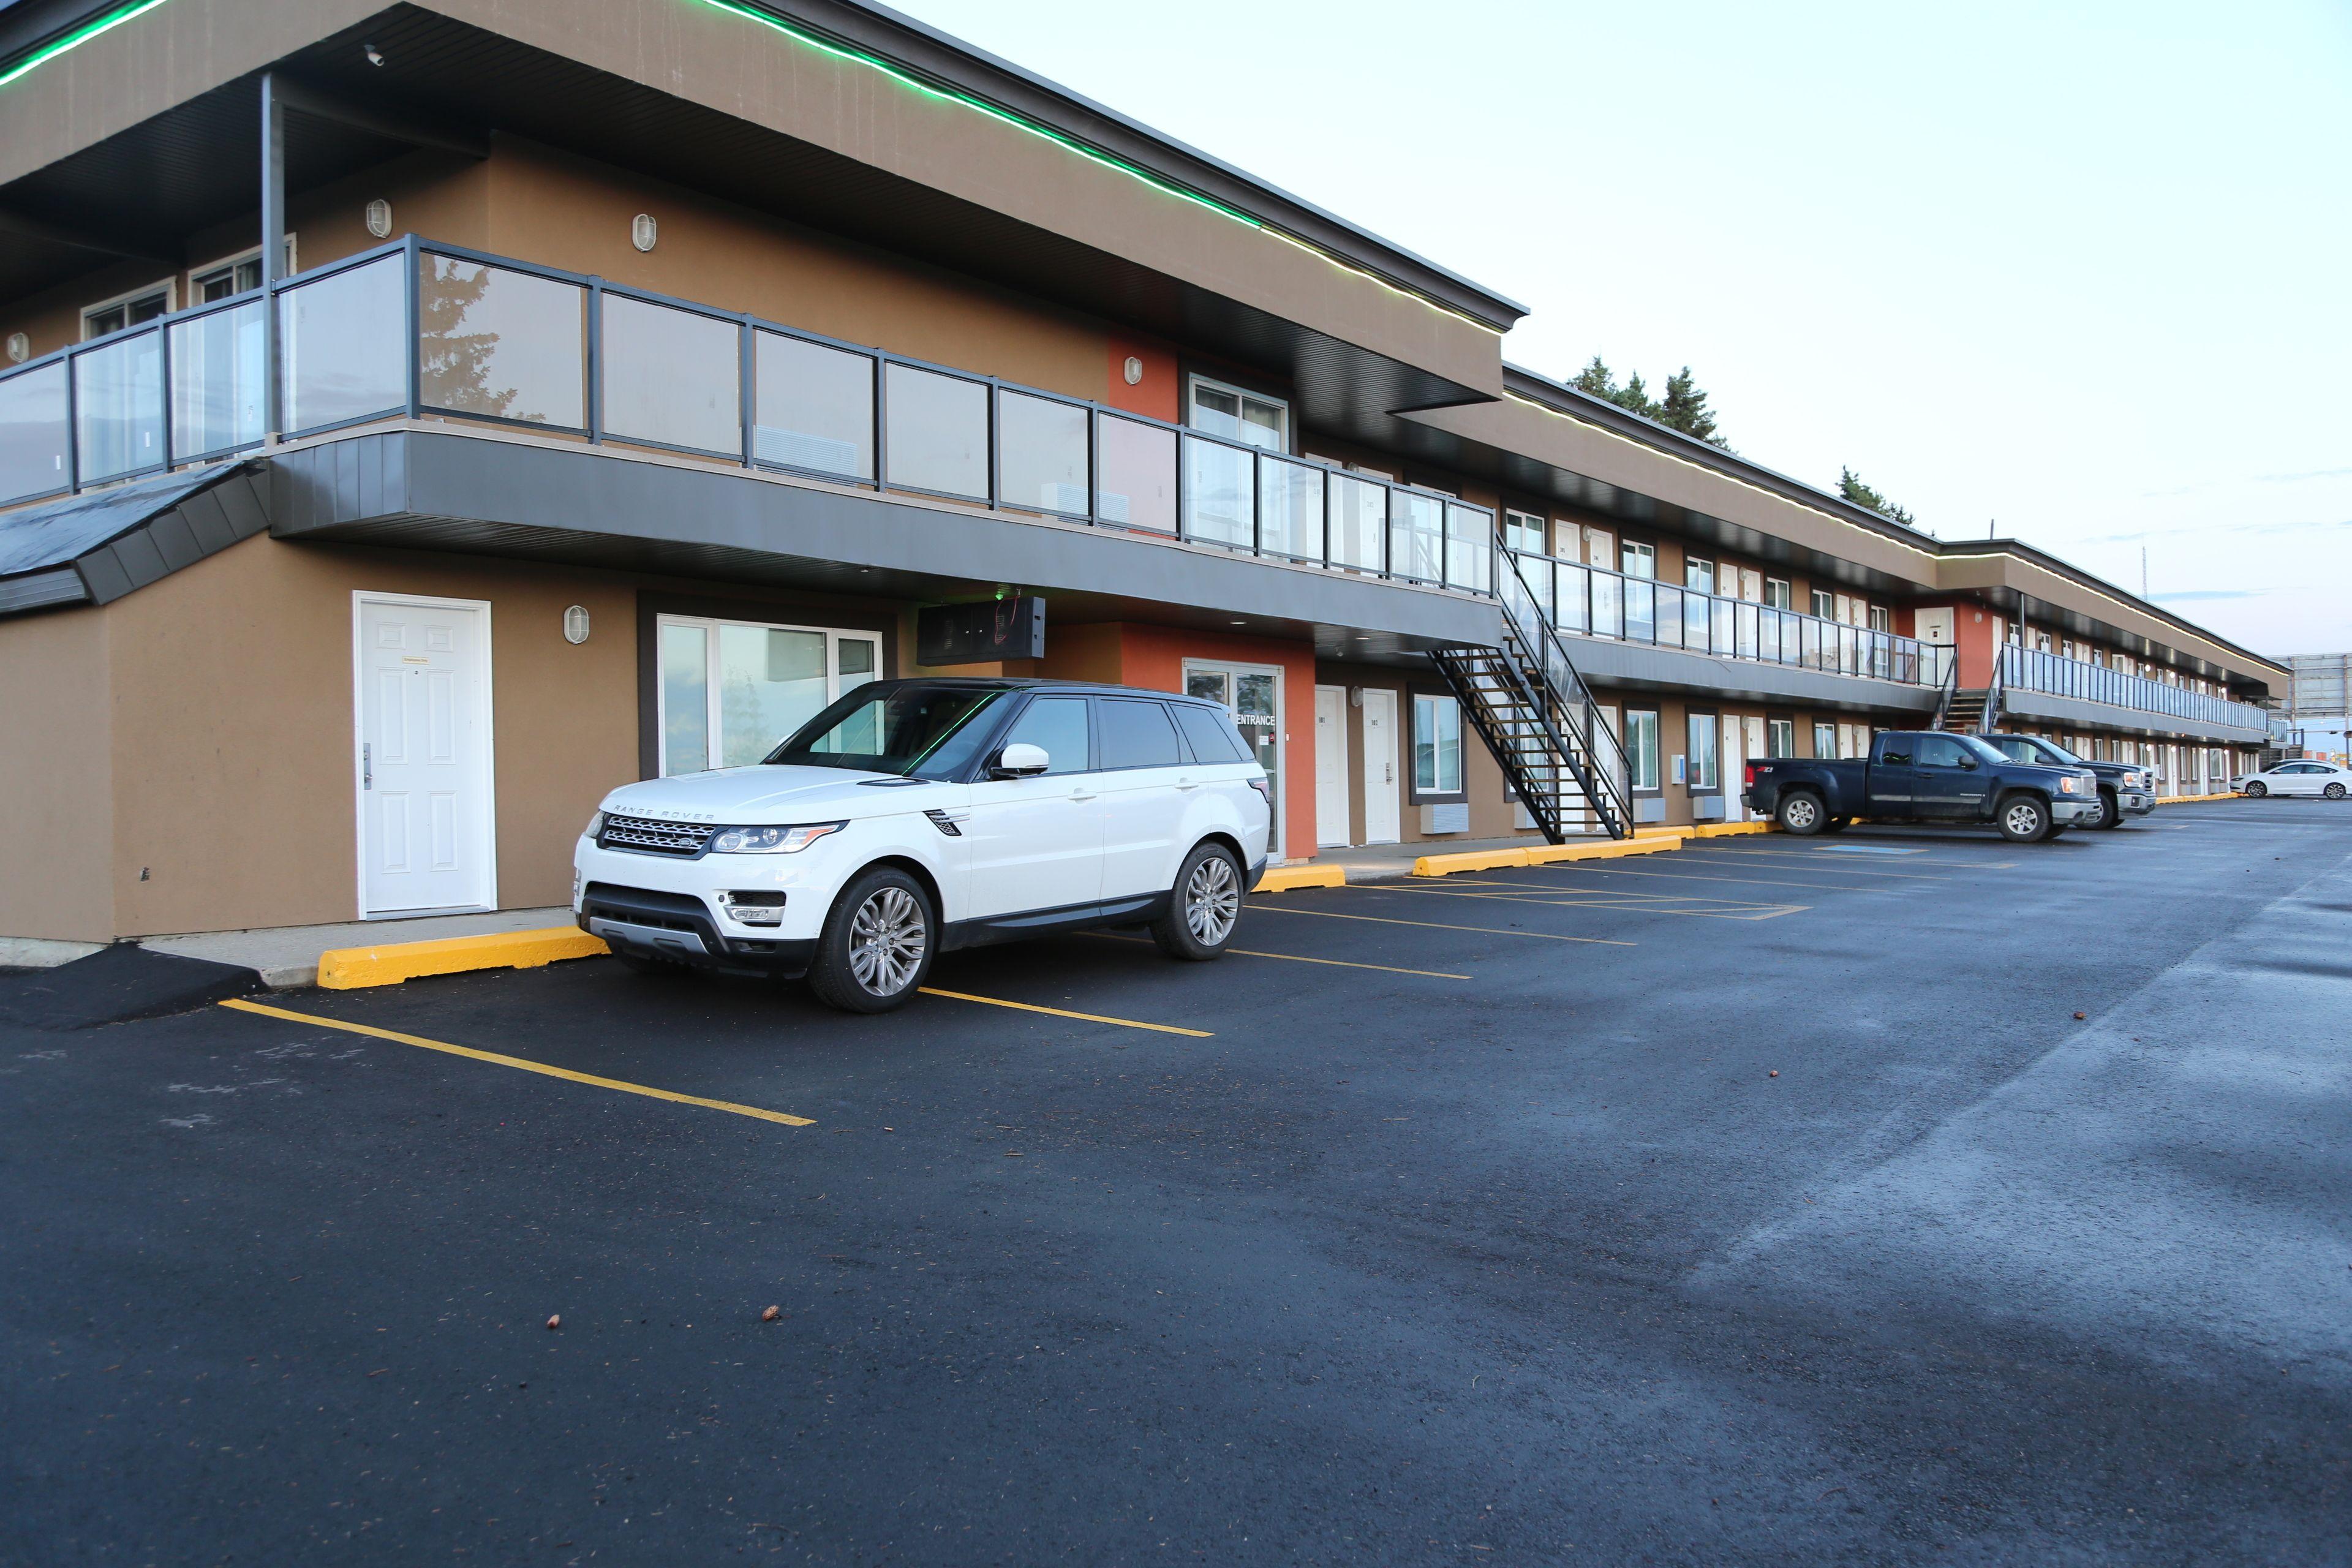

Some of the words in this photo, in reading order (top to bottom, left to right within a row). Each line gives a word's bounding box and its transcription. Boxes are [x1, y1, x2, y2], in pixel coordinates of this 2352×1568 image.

[1237, 714, 1275, 726] ENTRANCE
[613, 805, 654, 816] RANGE
[661, 811, 715, 821] ROVER
